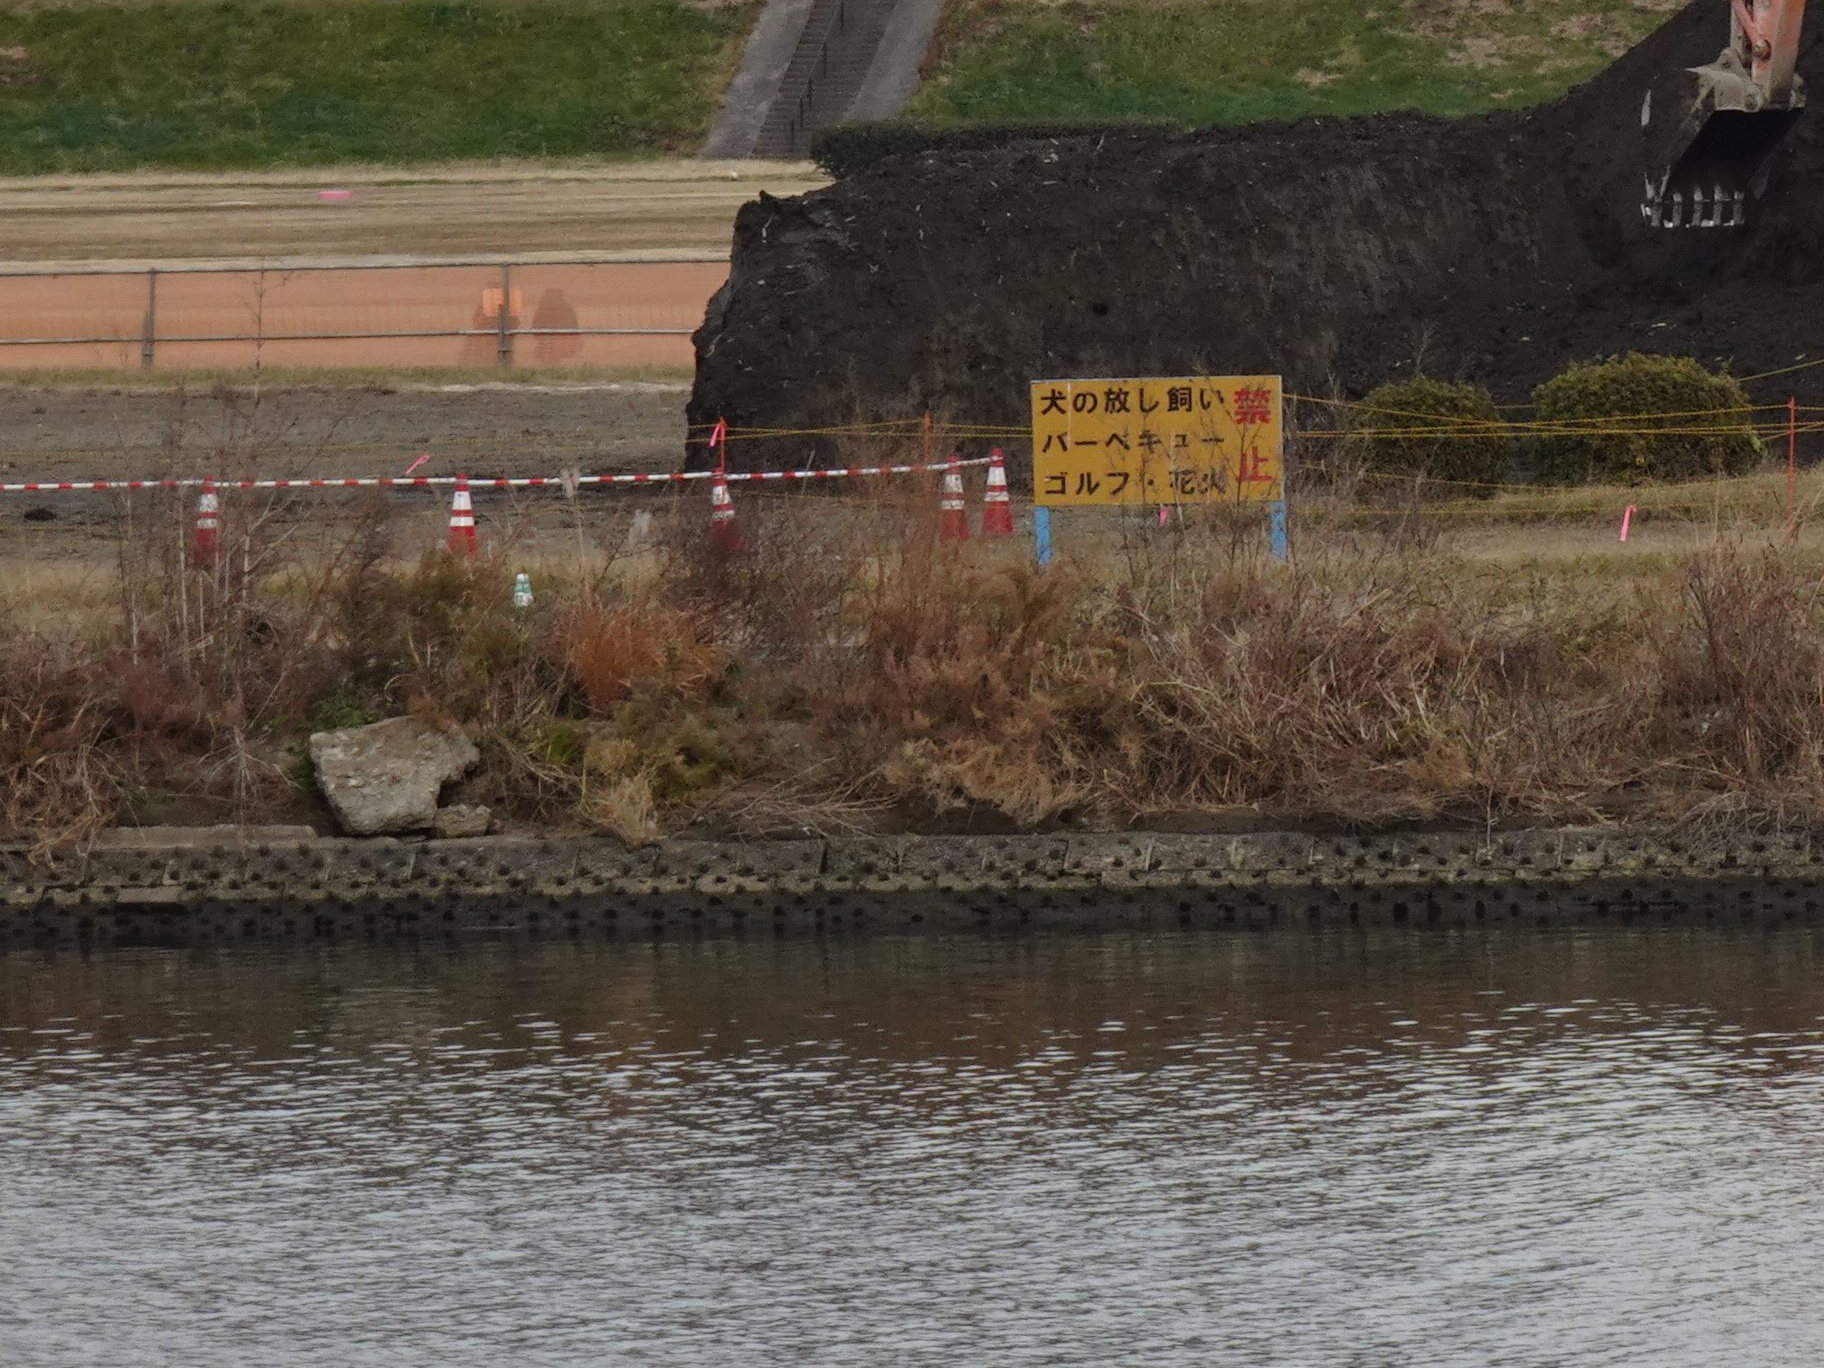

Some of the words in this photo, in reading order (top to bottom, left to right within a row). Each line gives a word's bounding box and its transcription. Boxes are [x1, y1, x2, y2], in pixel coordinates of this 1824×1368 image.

[1040, 387, 1225, 415] 犬の放し飼い
[1042, 430, 1225, 453] バーベキュー
[1233, 388, 1272, 482] 禁止
